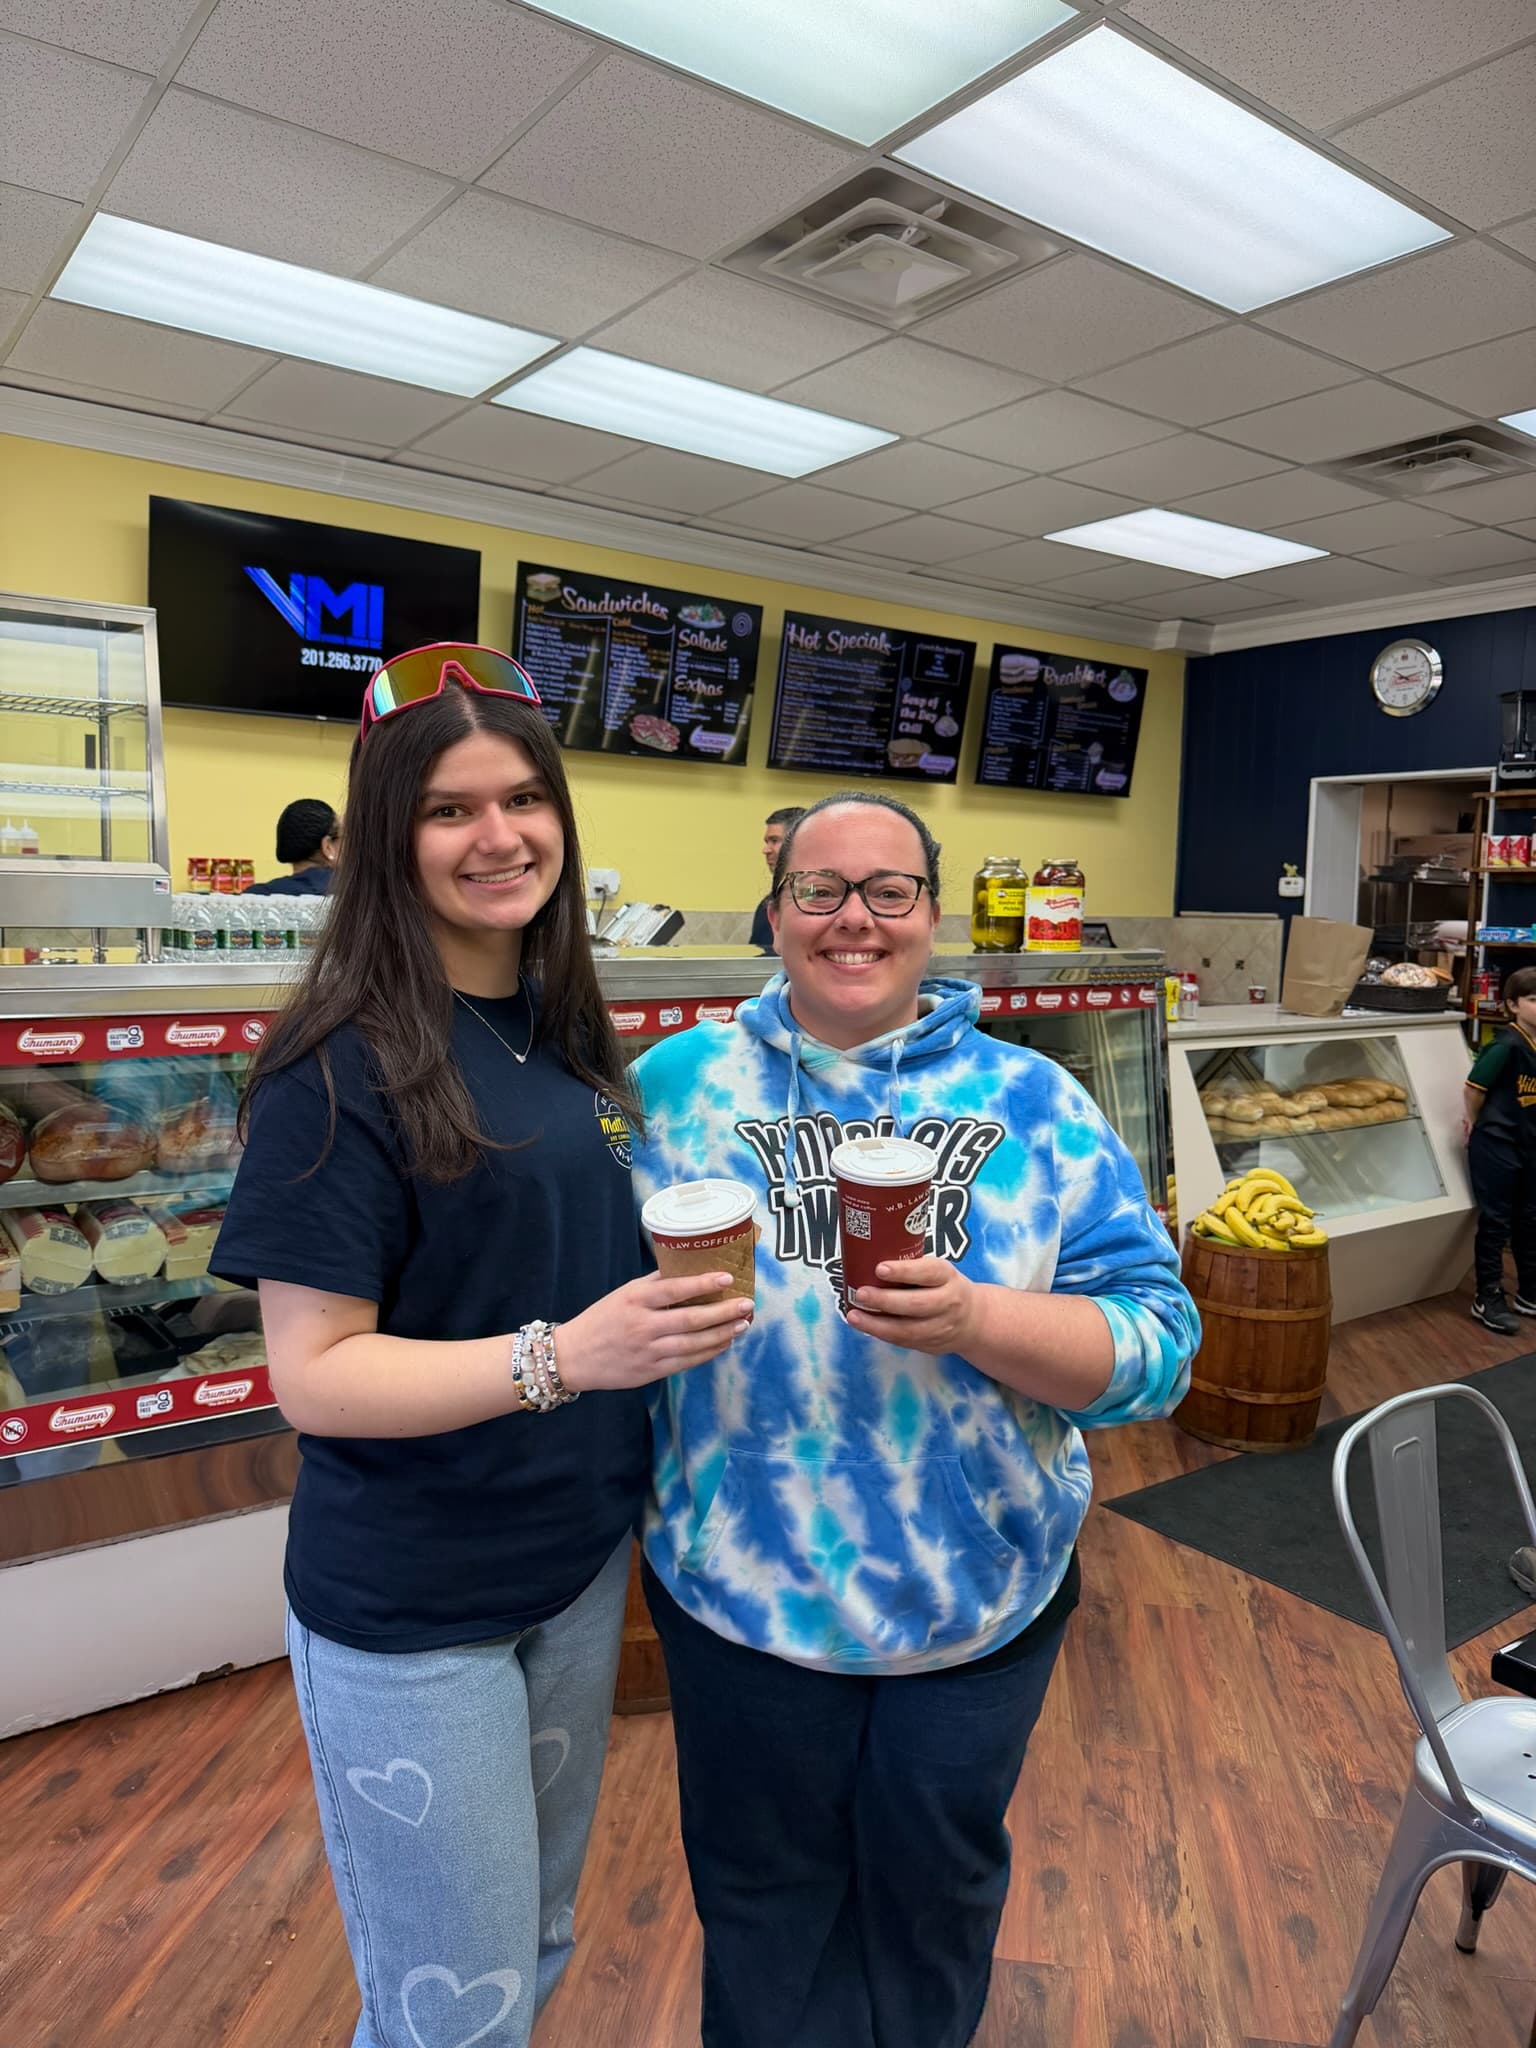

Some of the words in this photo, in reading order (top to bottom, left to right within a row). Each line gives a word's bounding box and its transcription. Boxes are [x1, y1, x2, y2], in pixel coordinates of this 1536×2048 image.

[243, 566, 384, 648] VMI
[562, 586, 669, 621] Sandwiches
[678, 628, 728, 652] Salads
[788, 621, 821, 651] Hot
[825, 630, 892, 656] Specials
[301, 648, 383, 673] 201.256.3770
[674, 674, 724, 697] Extras
[670, 1241, 690, 1250] LAW
[694, 1235, 734, 1248] COFFEE
